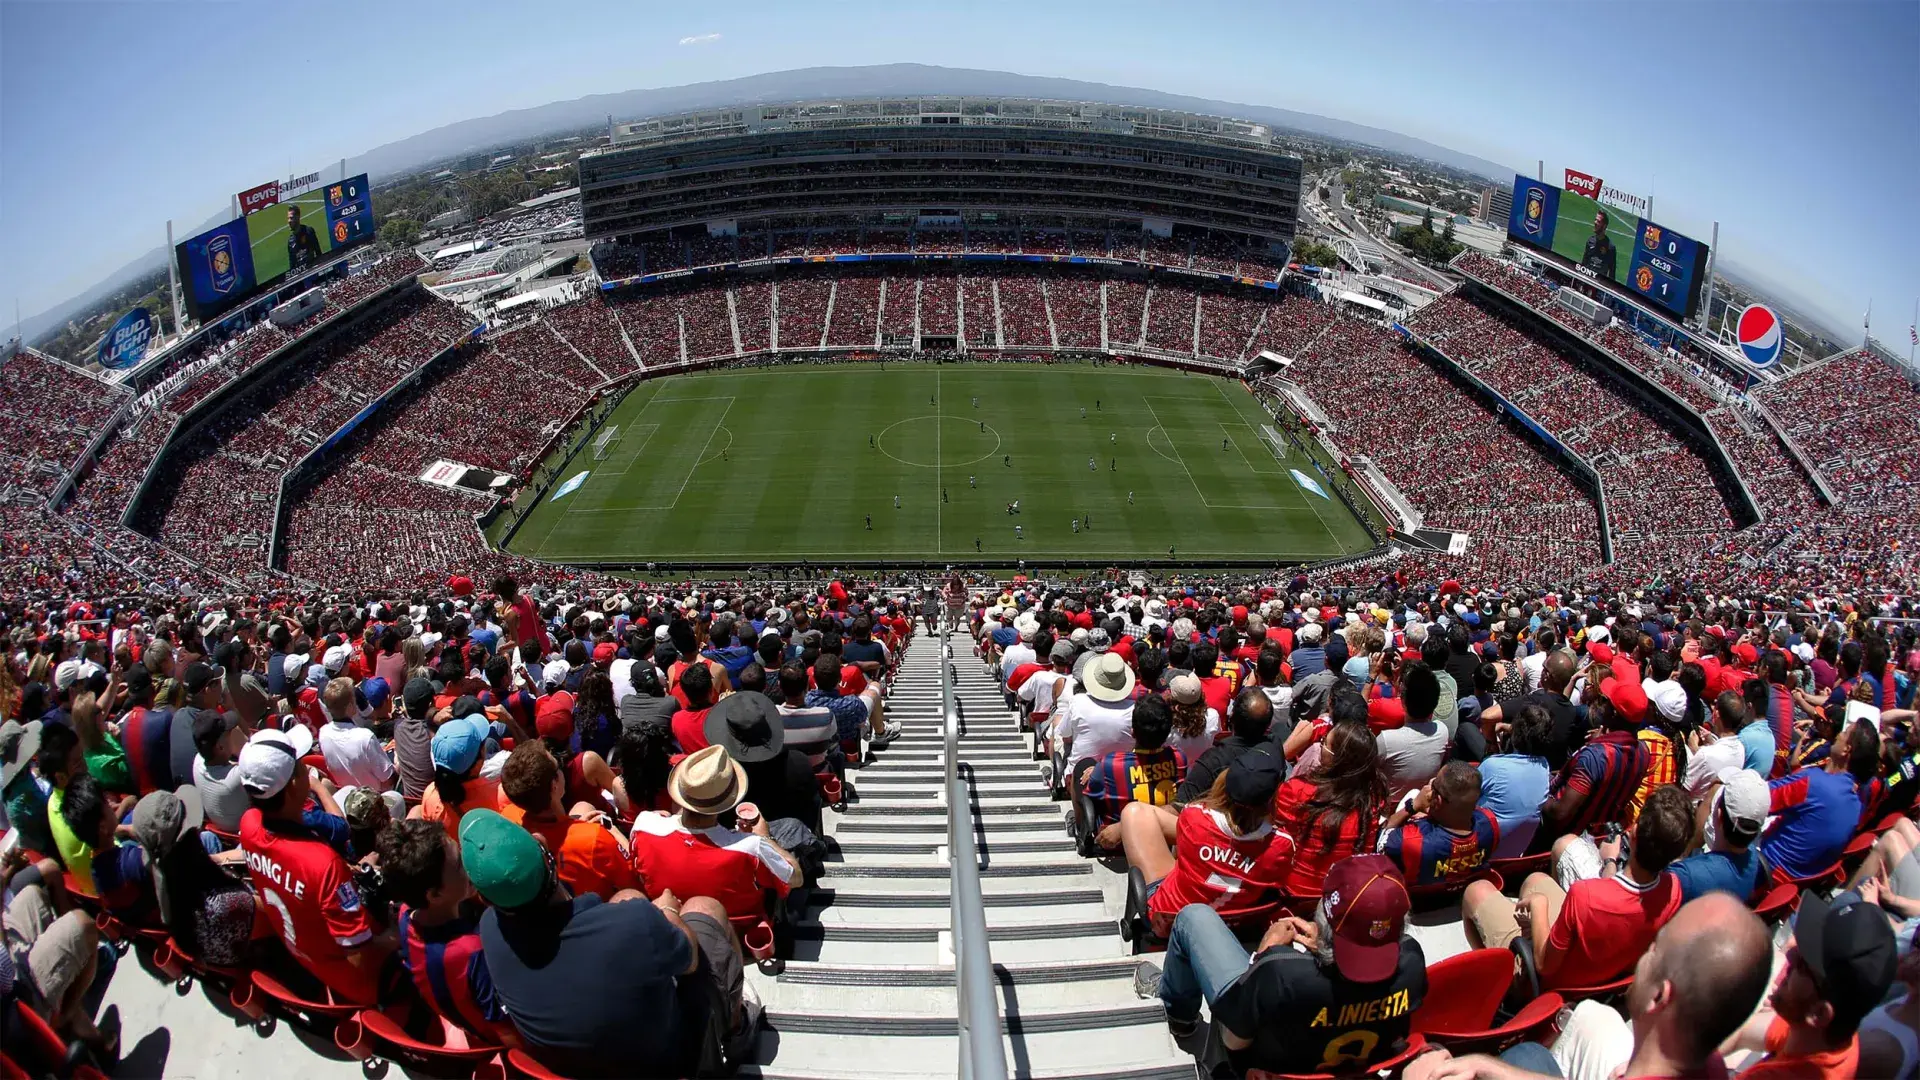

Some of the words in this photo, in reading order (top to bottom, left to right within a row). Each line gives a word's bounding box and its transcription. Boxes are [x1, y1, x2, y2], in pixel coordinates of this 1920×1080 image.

[349, 186, 356, 197] 0
[1602, 187, 1646, 210] STADIUM
[341, 204, 357, 216] 42:39
[354, 220, 360, 231] 1
[1668, 241, 1677, 254] 0
[285, 264, 308, 279] SONY
[1575, 263, 1598, 279] SONY
[1650, 257, 1671, 273] 42:39
[1661, 283, 1668, 296] 1
[115, 319, 145, 344] BUD
[110, 327, 151, 361] LIGHT
[1129, 760, 1175, 785] MESSI
[1132, 780, 1177, 806] 10
[1199, 845, 1256, 875] OWEN
[1433, 849, 1486, 878] MESSI
[284, 871, 306, 901] LE
[1204, 871, 1243, 909] 7
[1310, 1006, 1333, 1028] A.
[1336, 988, 1409, 1027] INIESTA
